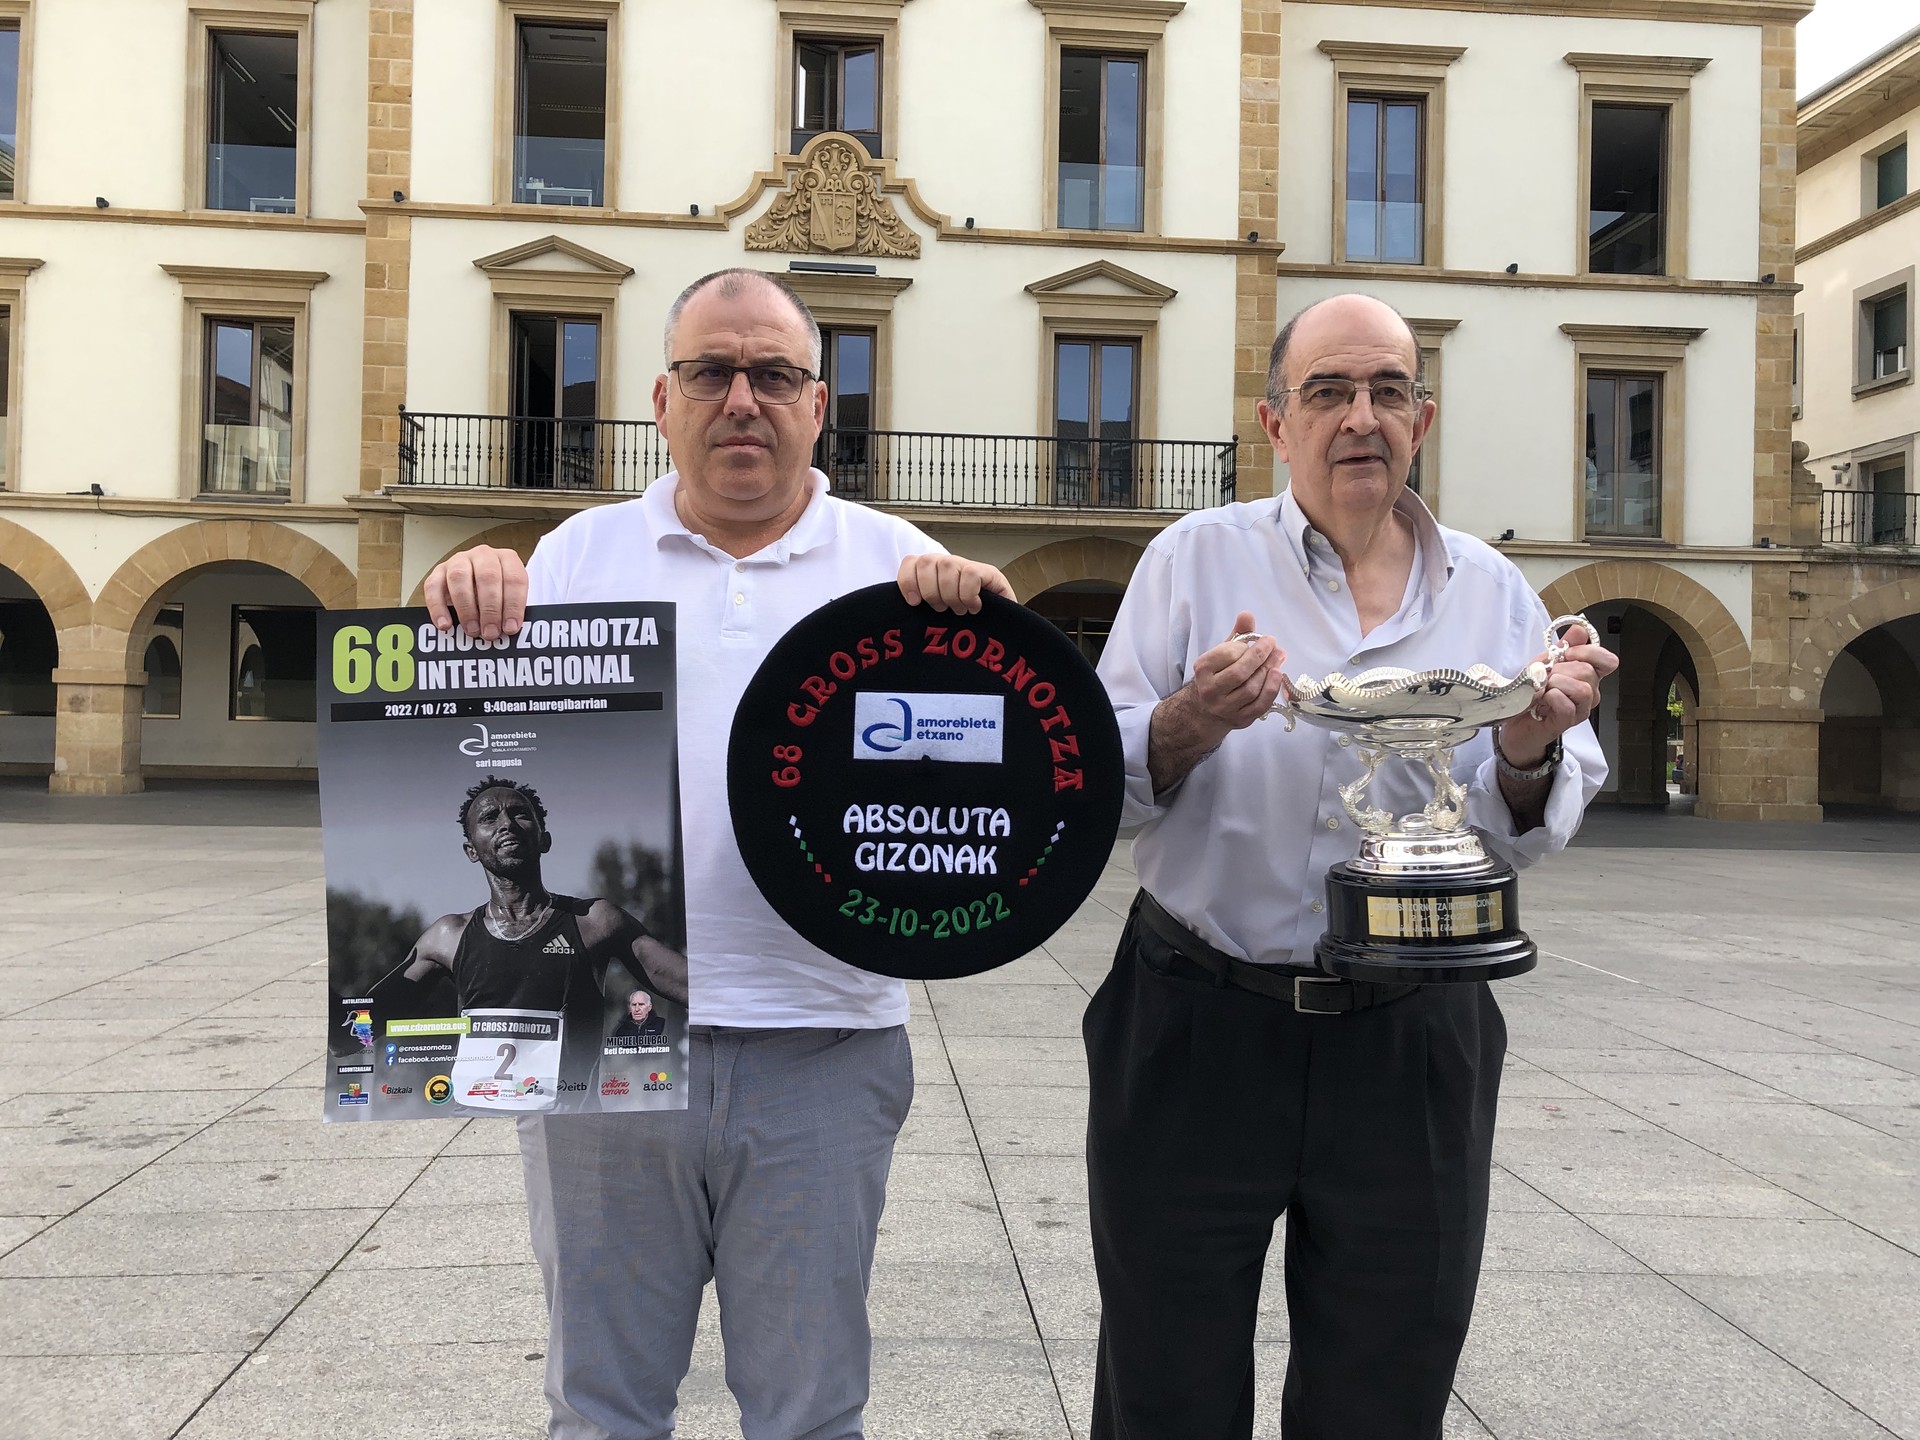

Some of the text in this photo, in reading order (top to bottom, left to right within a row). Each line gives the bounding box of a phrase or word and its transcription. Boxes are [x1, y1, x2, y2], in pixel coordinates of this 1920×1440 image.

[332, 624, 415, 694] 68
[516, 617, 659, 650] ZORNOTZA
[418, 654, 635, 691] INTERNACIONAL
[384, 704, 412, 717] 2022
[420, 703, 433, 716] 10
[443, 702, 457, 715] 23
[483, 697, 608, 713] 9:40ean Jauregibarrian
[771, 626, 1084, 793] 68 CROSS ZORNOTZA
[916, 717, 997, 731] amorebieta
[490, 731, 537, 740] amorebieta
[916, 729, 964, 742] etxano
[490, 739, 519, 747] etxano
[475, 757, 523, 768] sari nagusia
[843, 803, 1011, 837] ABSOLUTA
[854, 843, 998, 875] GIZONAK
[838, 889, 1010, 938] 23-10-2022
[542, 946, 575, 955] adidas
[390, 1022, 467, 1033] www.cdzornotza.eus
[481, 1021, 508, 1032] CROSS
[508, 1022, 552, 1035] ZORNOTZA
[606, 1034, 668, 1047] MIGUEL BILBAO
[398, 1044, 452, 1053] @crosszornotza
[618, 1047, 637, 1055] Cross
[638, 1046, 670, 1054] Zornotzan
[494, 1043, 517, 1080] 2
[386, 1086, 413, 1095] Bizkaia
[567, 1081, 587, 1091] eitb
[643, 1081, 673, 1092] adoc
